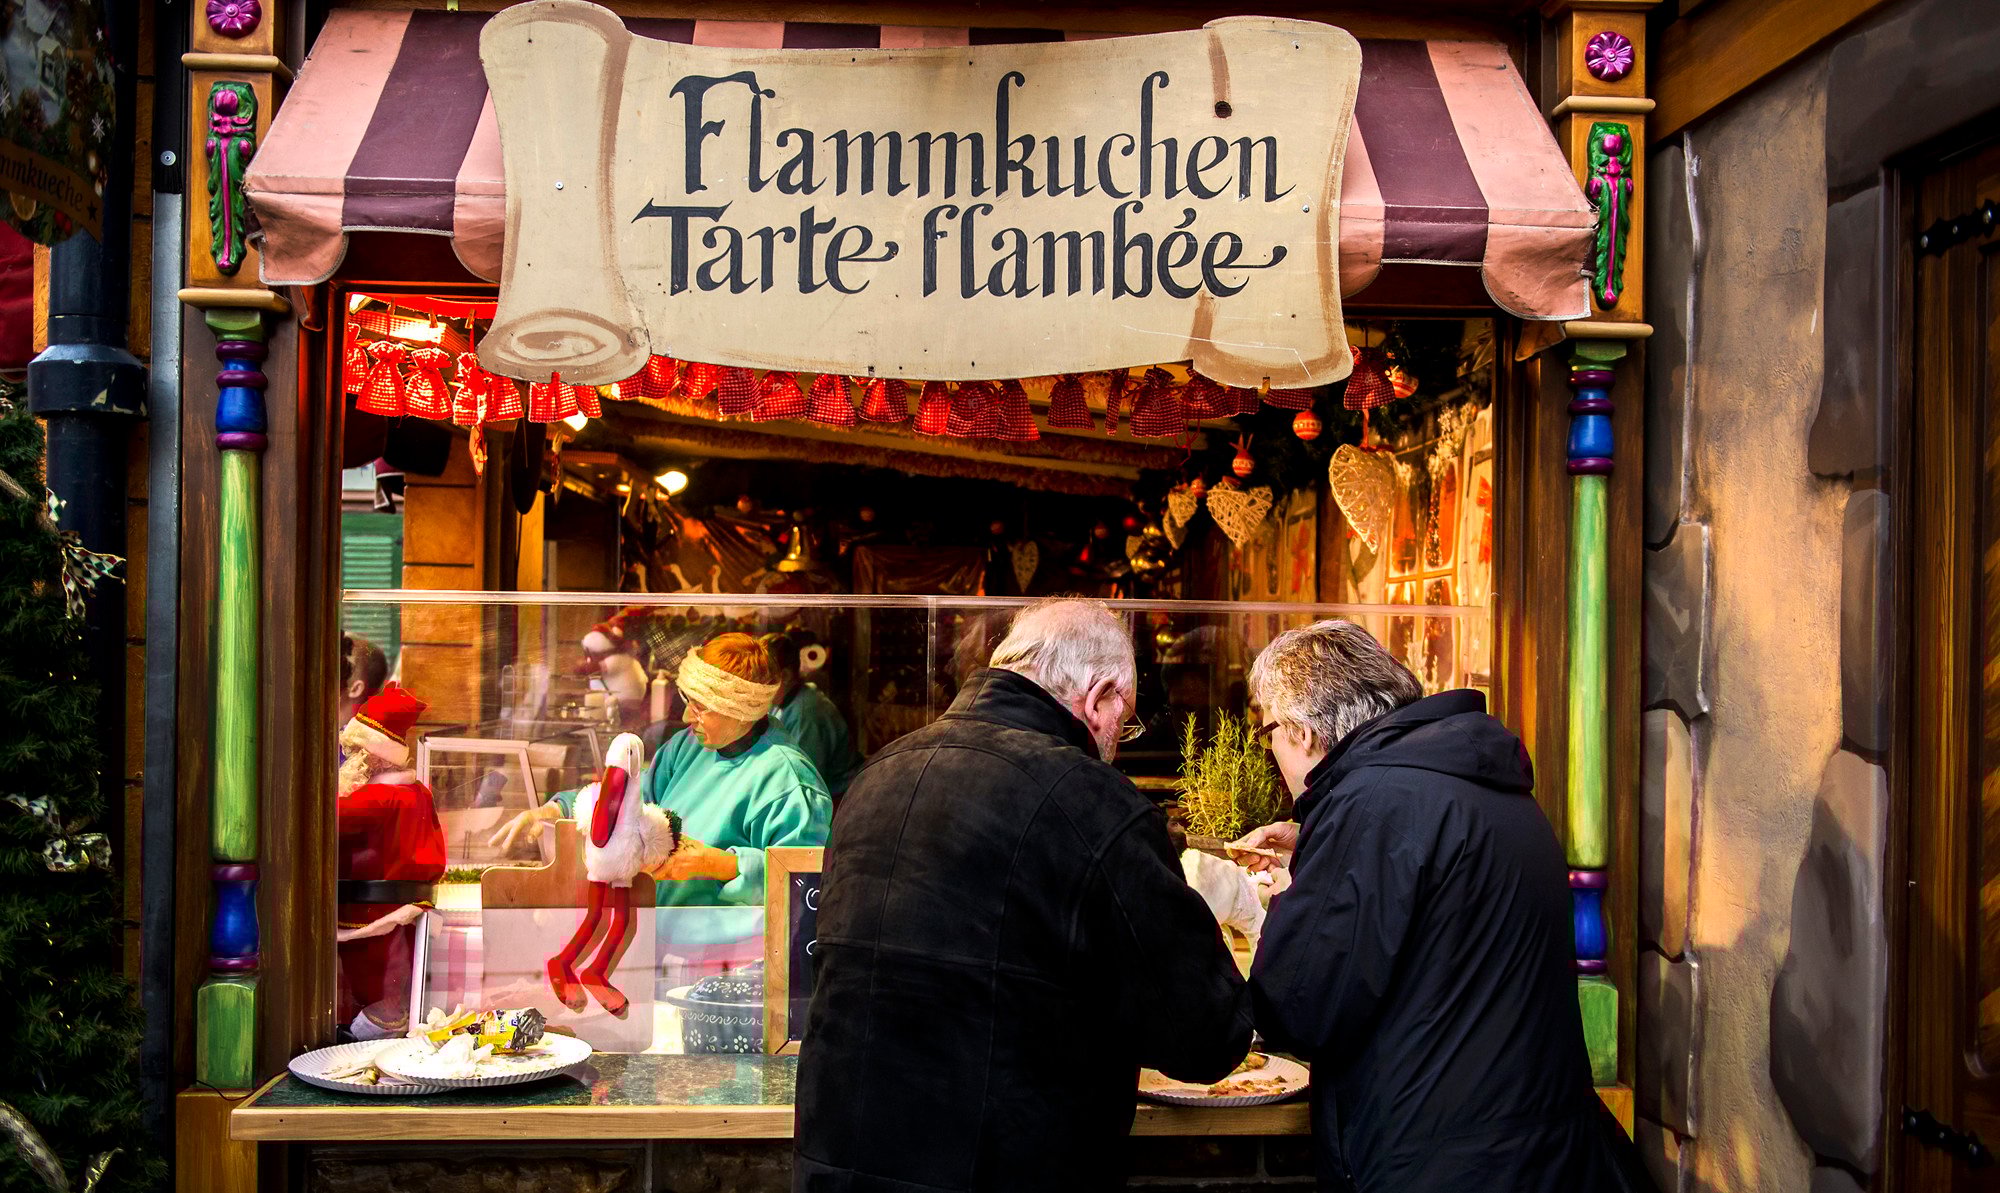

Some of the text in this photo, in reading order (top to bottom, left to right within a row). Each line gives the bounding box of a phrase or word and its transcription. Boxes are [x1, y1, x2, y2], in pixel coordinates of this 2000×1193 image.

[670, 70, 1296, 202] Flammkuchen
[631, 197, 1288, 301] Tarte flambée
